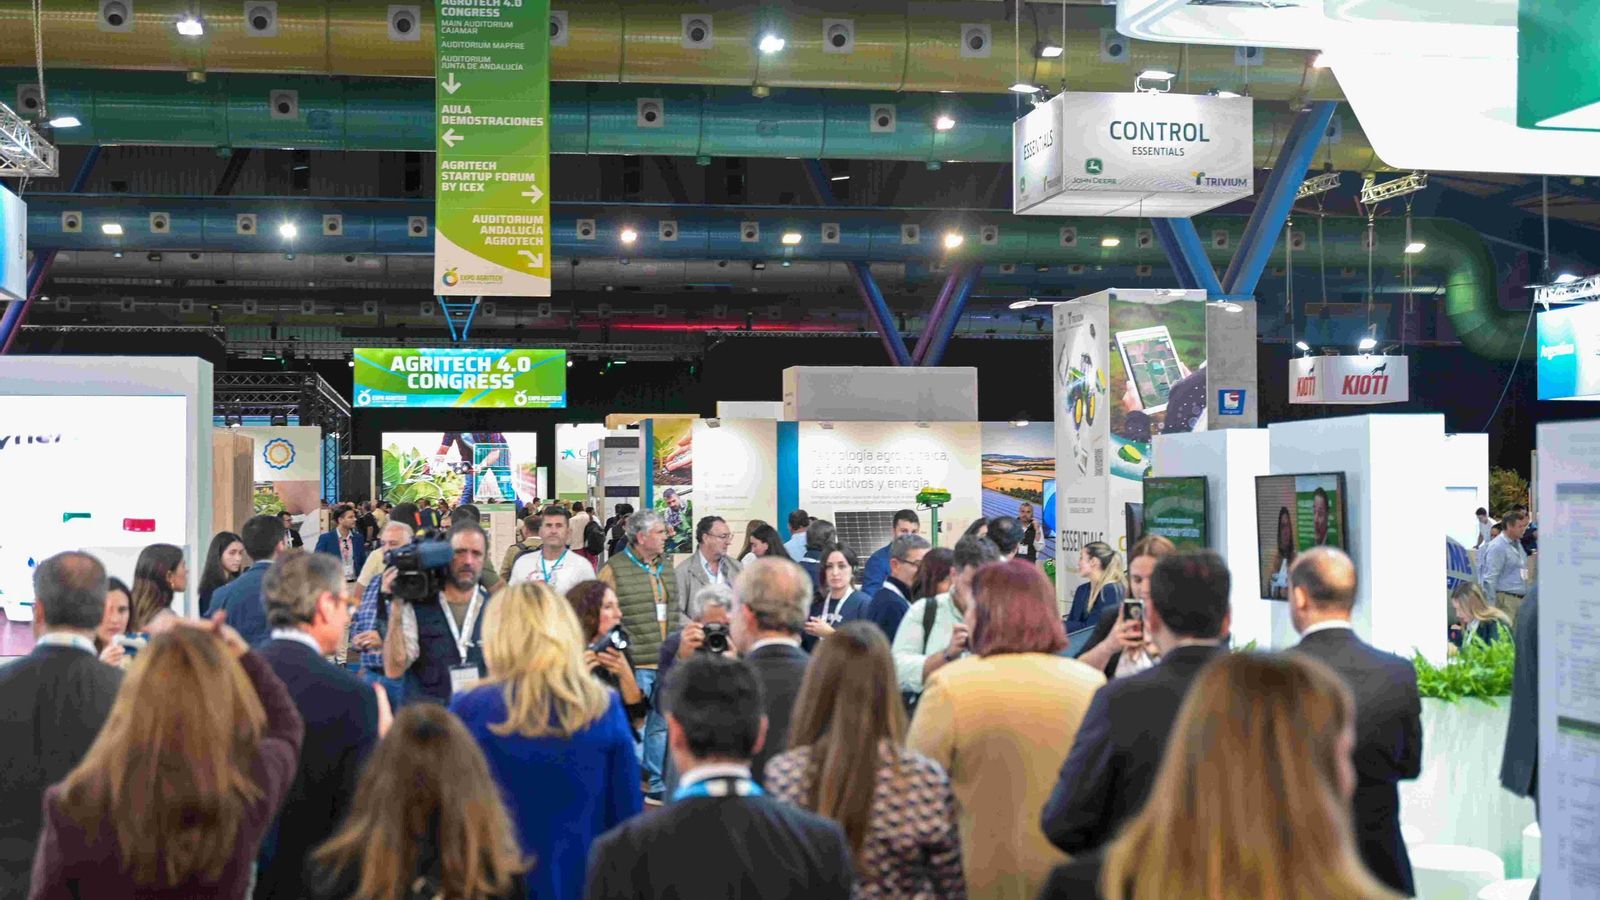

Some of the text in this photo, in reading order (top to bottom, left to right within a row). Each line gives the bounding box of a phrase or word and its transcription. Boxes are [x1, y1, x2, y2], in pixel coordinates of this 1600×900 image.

[441, 7, 500, 17] CONGRESS
[464, 20, 514, 28] AUDITORIUM
[480, 62, 523, 70] ANDALUCÍA
[441, 105, 471, 114] AULA
[441, 115, 544, 126] DEMOSTRACIONES
[1110, 120, 1210, 142] CONTROL
[1132, 146, 1185, 156] ESSENTIALS
[441, 161, 497, 170] AGRITECH
[441, 171, 535, 182] STARTUP FORUM
[1205, 177, 1247, 187] TRIVIUM
[441, 182, 485, 192] BY ICEX
[472, 214, 544, 224] AUDITORIUM
[480, 224, 544, 235] ANDALUCÍA
[484, 236, 544, 246] AGROTECH
[390, 356, 531, 372] AGRITECH 4.0
[407, 373, 515, 389] CONGRESS
[1297, 375, 1316, 396] KIOTI
[1342, 375, 1389, 395] KIOTI
[811, 449, 873, 463] ología
[825, 463, 860, 475] usión
[811, 477, 930, 491] de cultivos y energía
